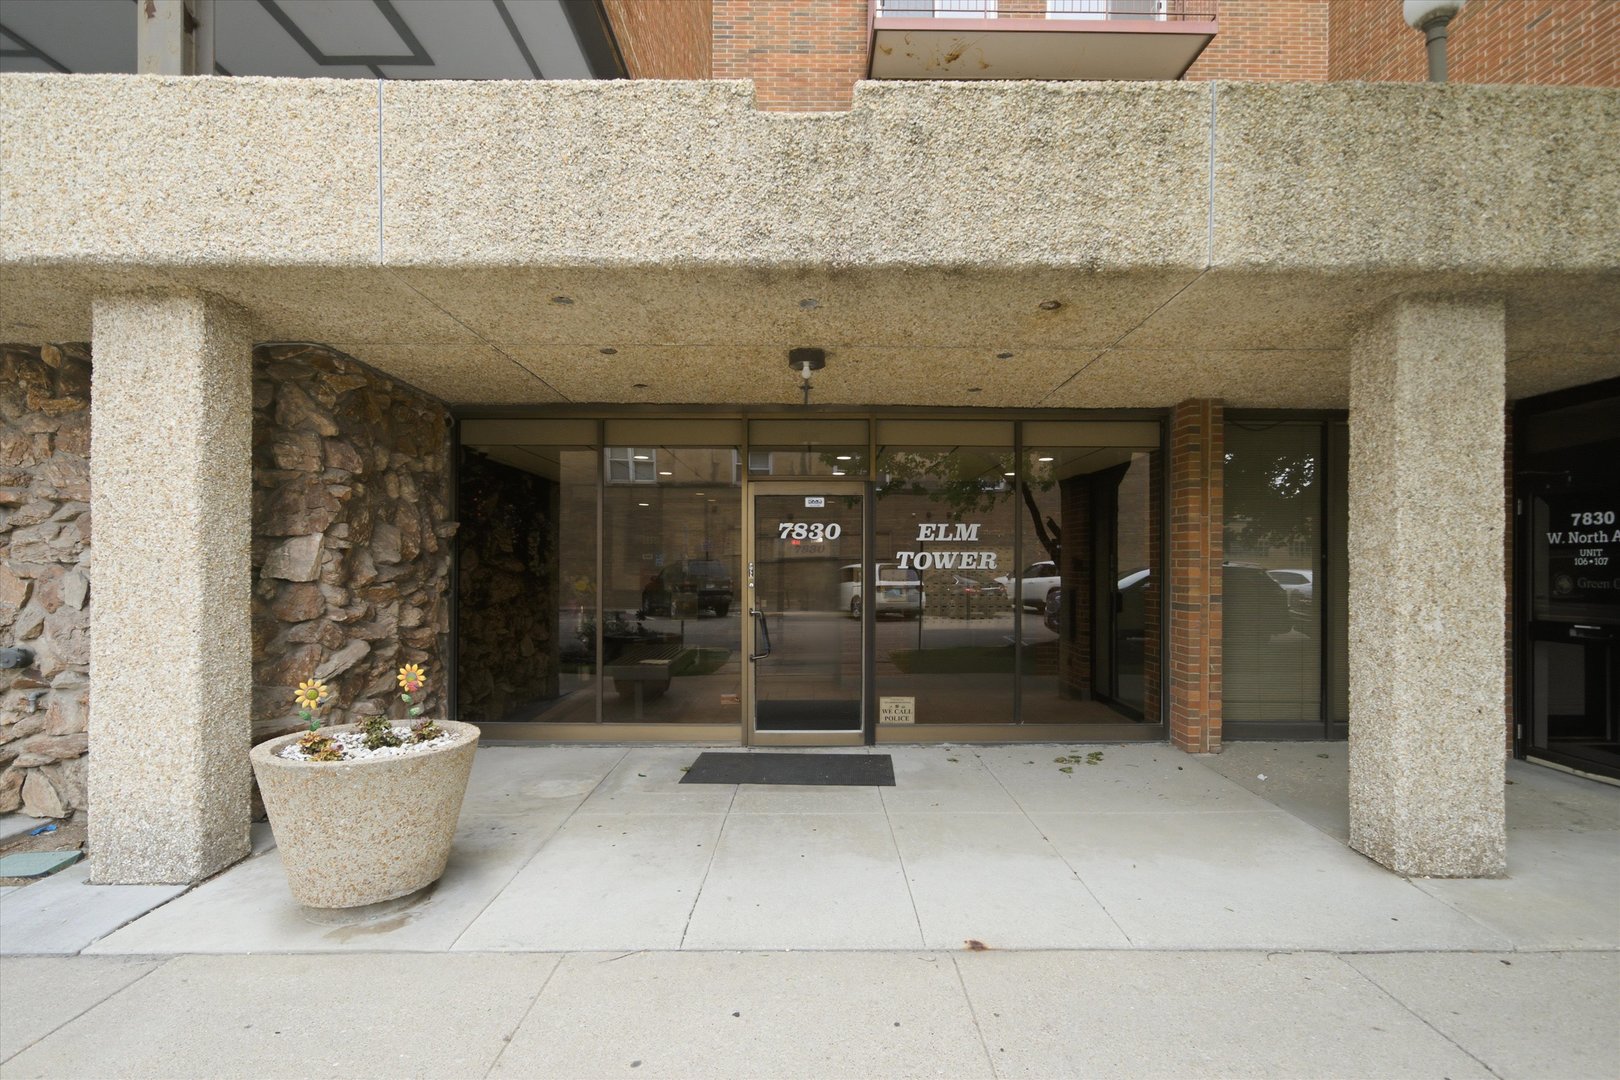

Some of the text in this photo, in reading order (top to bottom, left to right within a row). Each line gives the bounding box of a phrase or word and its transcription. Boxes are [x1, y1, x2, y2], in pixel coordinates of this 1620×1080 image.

[1571, 511, 1615, 526] 7830
[778, 522, 841, 540] 7830
[916, 523, 981, 541] ELM
[1546, 532, 1565, 544] W.
[1568, 530, 1609, 544] North
[896, 551, 998, 570] TOWER
[1579, 549, 1603, 557] UNIT
[1577, 577, 1610, 589] Green
